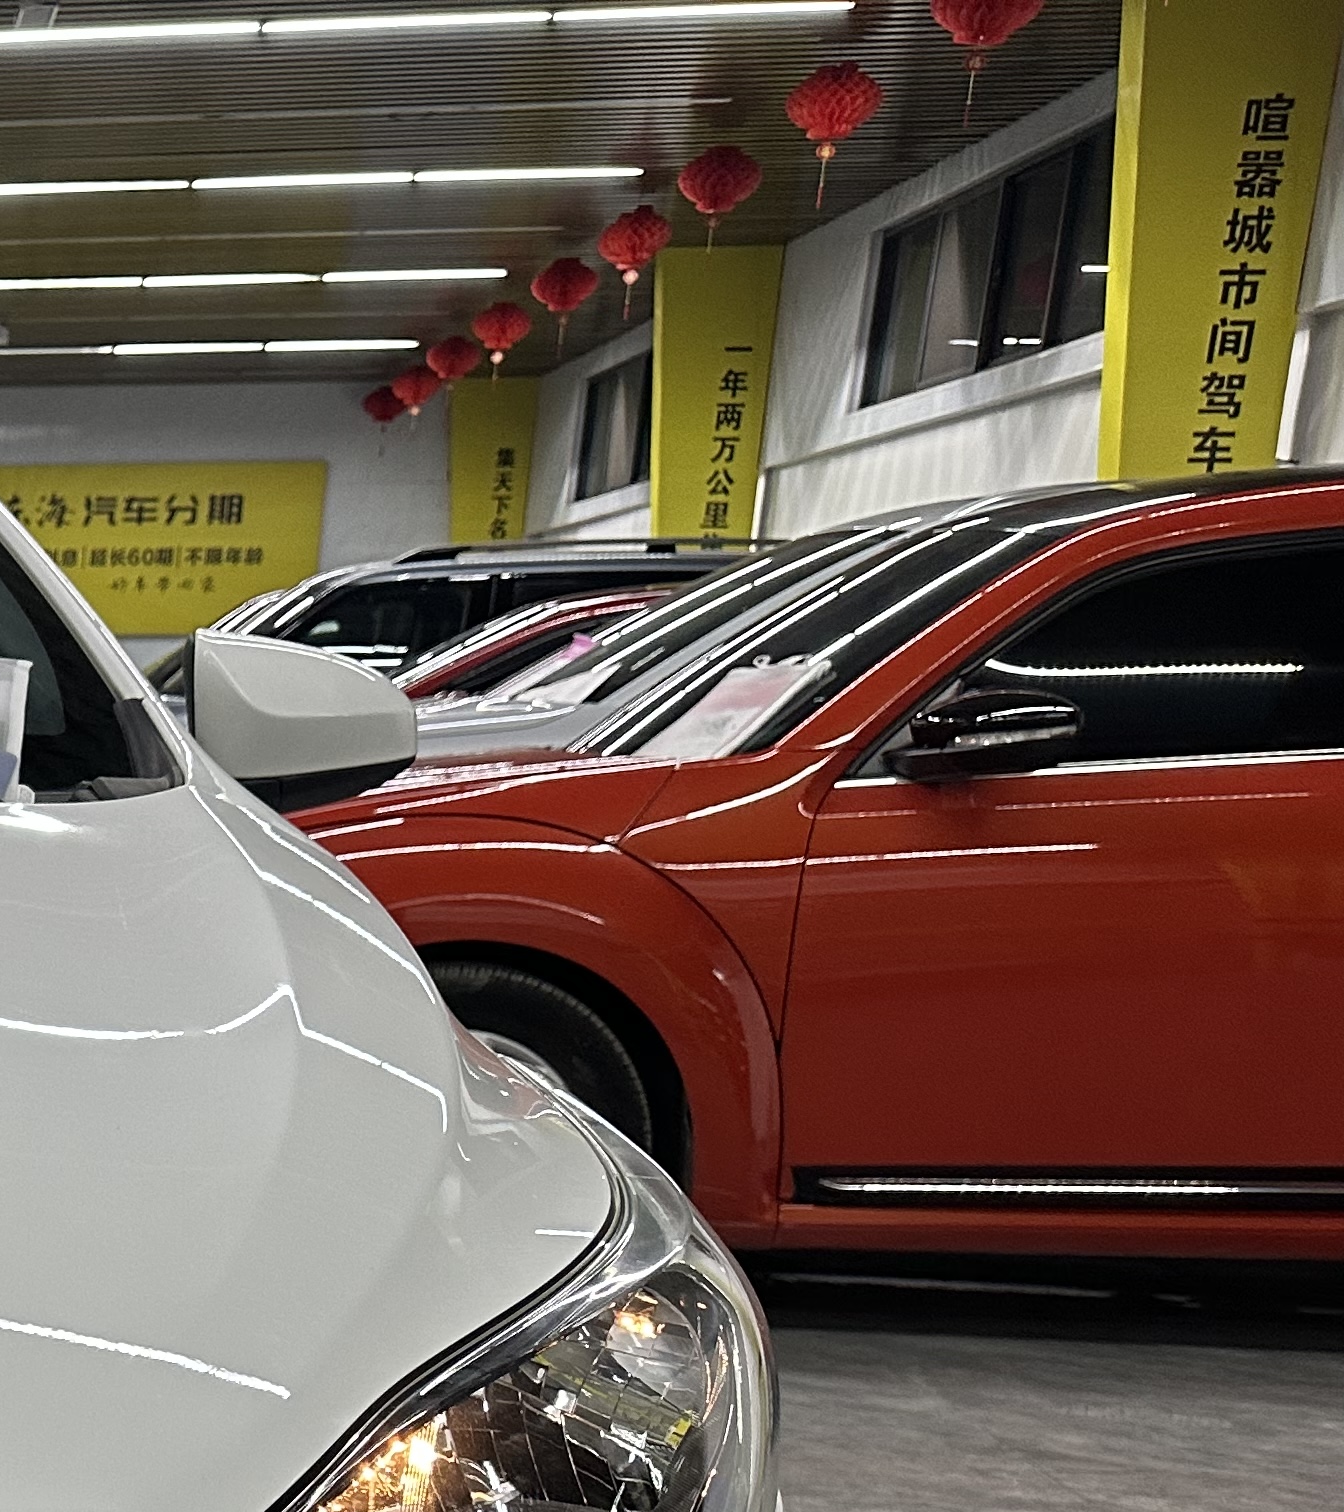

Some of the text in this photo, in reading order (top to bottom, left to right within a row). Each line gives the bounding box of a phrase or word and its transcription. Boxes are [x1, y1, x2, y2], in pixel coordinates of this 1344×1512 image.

[1187, 93, 1296, 473] 喧嚣城市间驾车
